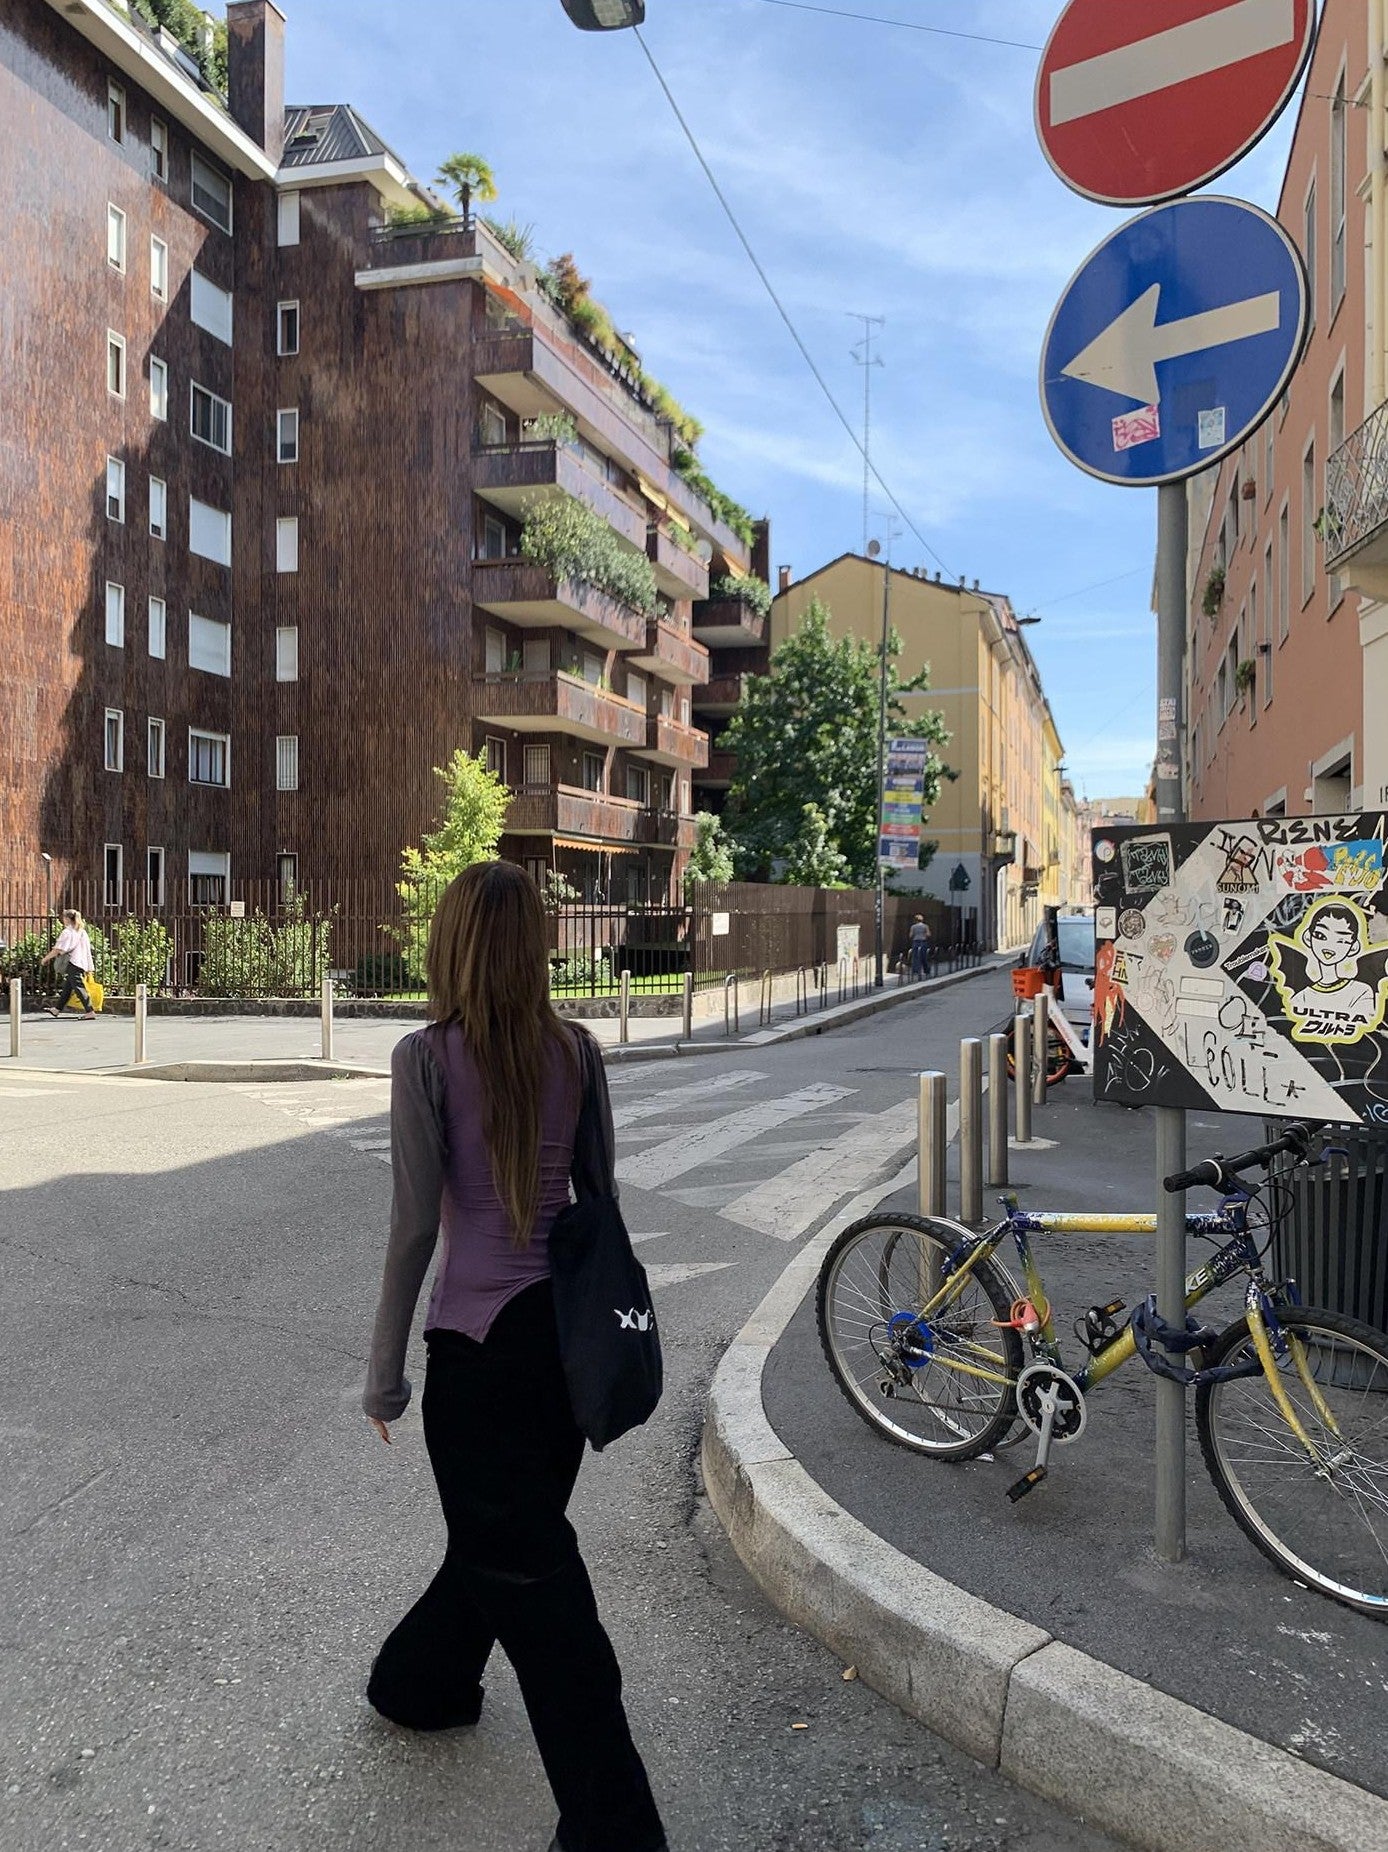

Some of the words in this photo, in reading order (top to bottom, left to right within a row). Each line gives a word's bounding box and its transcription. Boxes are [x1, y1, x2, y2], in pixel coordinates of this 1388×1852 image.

[1293, 1006, 1368, 1024] ULTRA
[1300, 1020, 1356, 1036] ウルトラ
